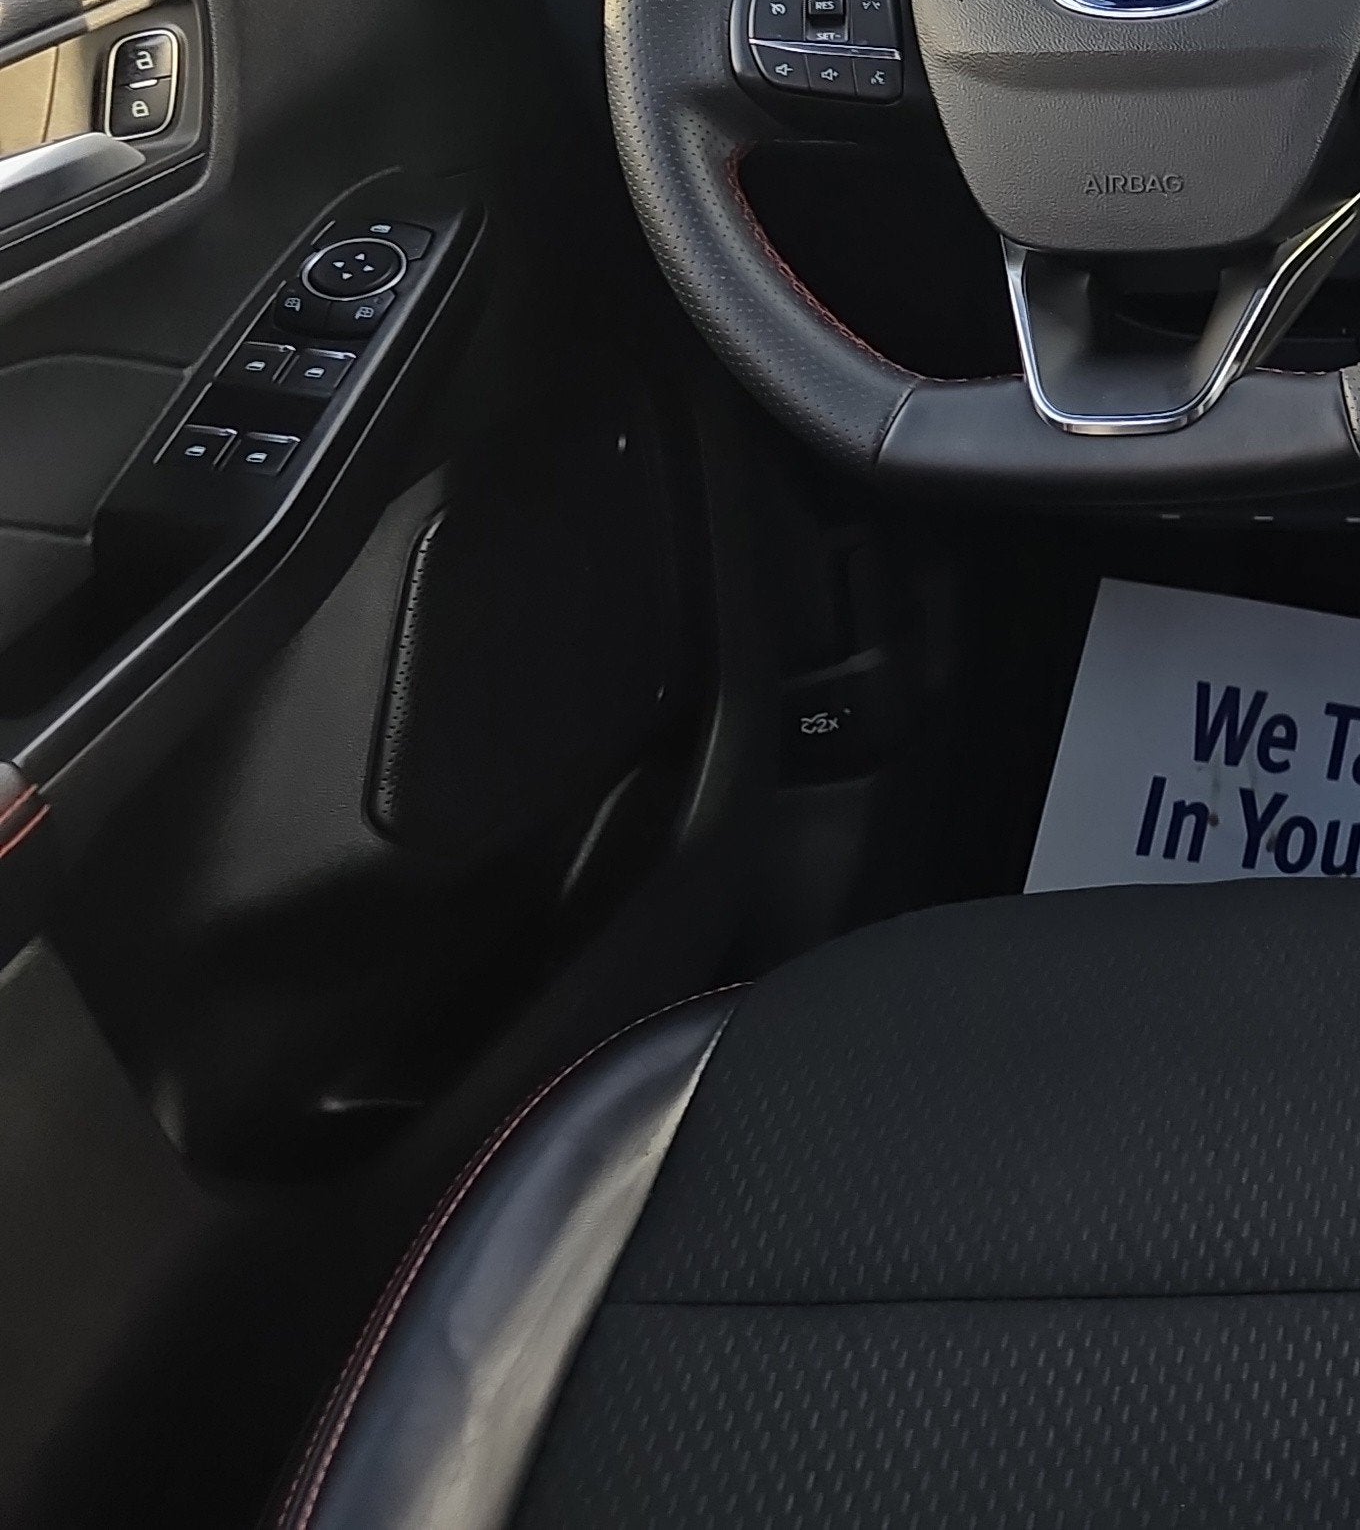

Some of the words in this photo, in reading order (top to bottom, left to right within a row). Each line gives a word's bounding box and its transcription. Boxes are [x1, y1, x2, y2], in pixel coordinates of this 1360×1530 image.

[815, 0, 835, 10] RES
[1083, 174, 1186, 197] AIRBAG
[1193, 681, 1299, 774] We
[1134, 775, 1212, 862] In
